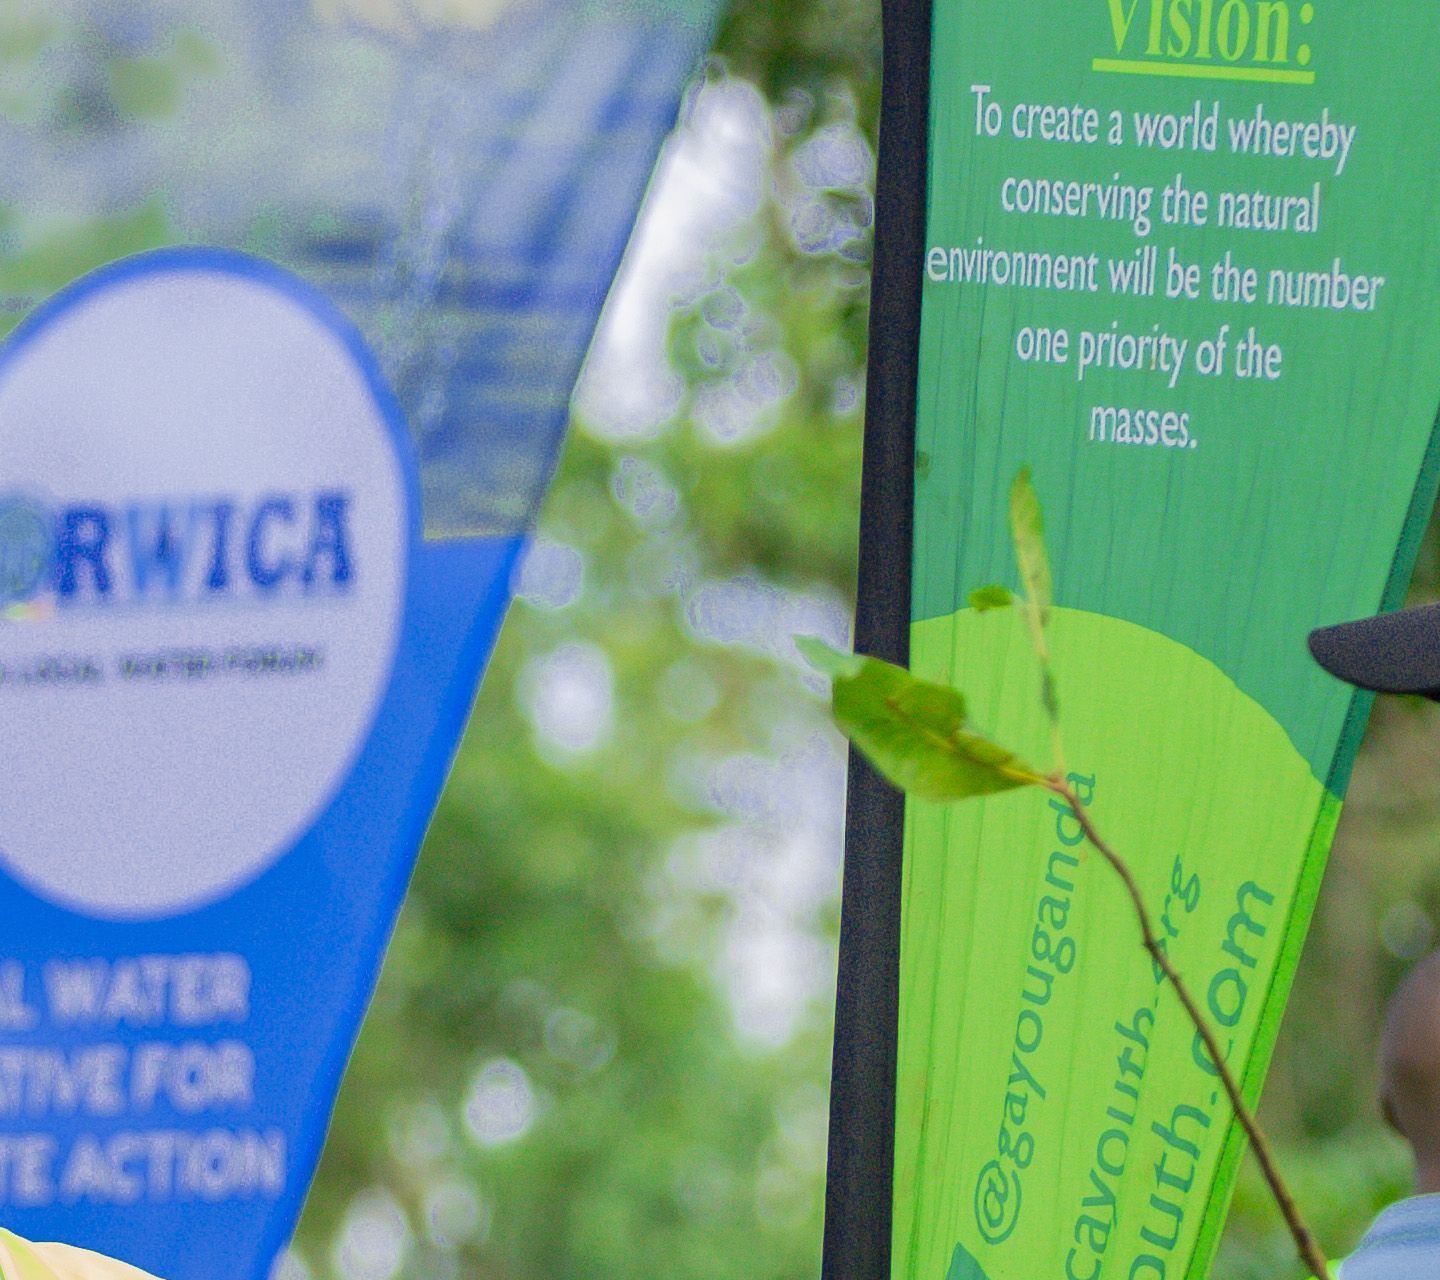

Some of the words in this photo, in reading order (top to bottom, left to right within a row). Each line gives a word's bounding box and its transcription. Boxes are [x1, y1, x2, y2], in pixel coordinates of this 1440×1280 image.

[970, 85, 1003, 137] To
[1011, 97, 1099, 144] create
[1108, 110, 1123, 145] a
[1134, 100, 1219, 152] world
[1228, 104, 1356, 176] whereby
[1001, 172, 1153, 236] conserving
[1161, 174, 1208, 228] the
[1218, 182, 1320, 233] natural
[926, 237, 1099, 293] environment
[1108, 246, 1157, 296] will
[1166, 247, 1200, 299] be
[1211, 251, 1257, 303] the
[1267, 258, 1385, 310] number
[1016, 326, 1068, 363] one
[1078, 321, 1188, 388] priority
[1196, 325, 1230, 376] of
[1235, 328, 1282, 379] the
[1089, 405, 1197, 449] masses.
[42, 952, 252, 1027] WATER
[975, 771, 1095, 1244] @gayouganda
[131, 1040, 255, 1114] FOR
[59, 1126, 287, 1205] ACTION
